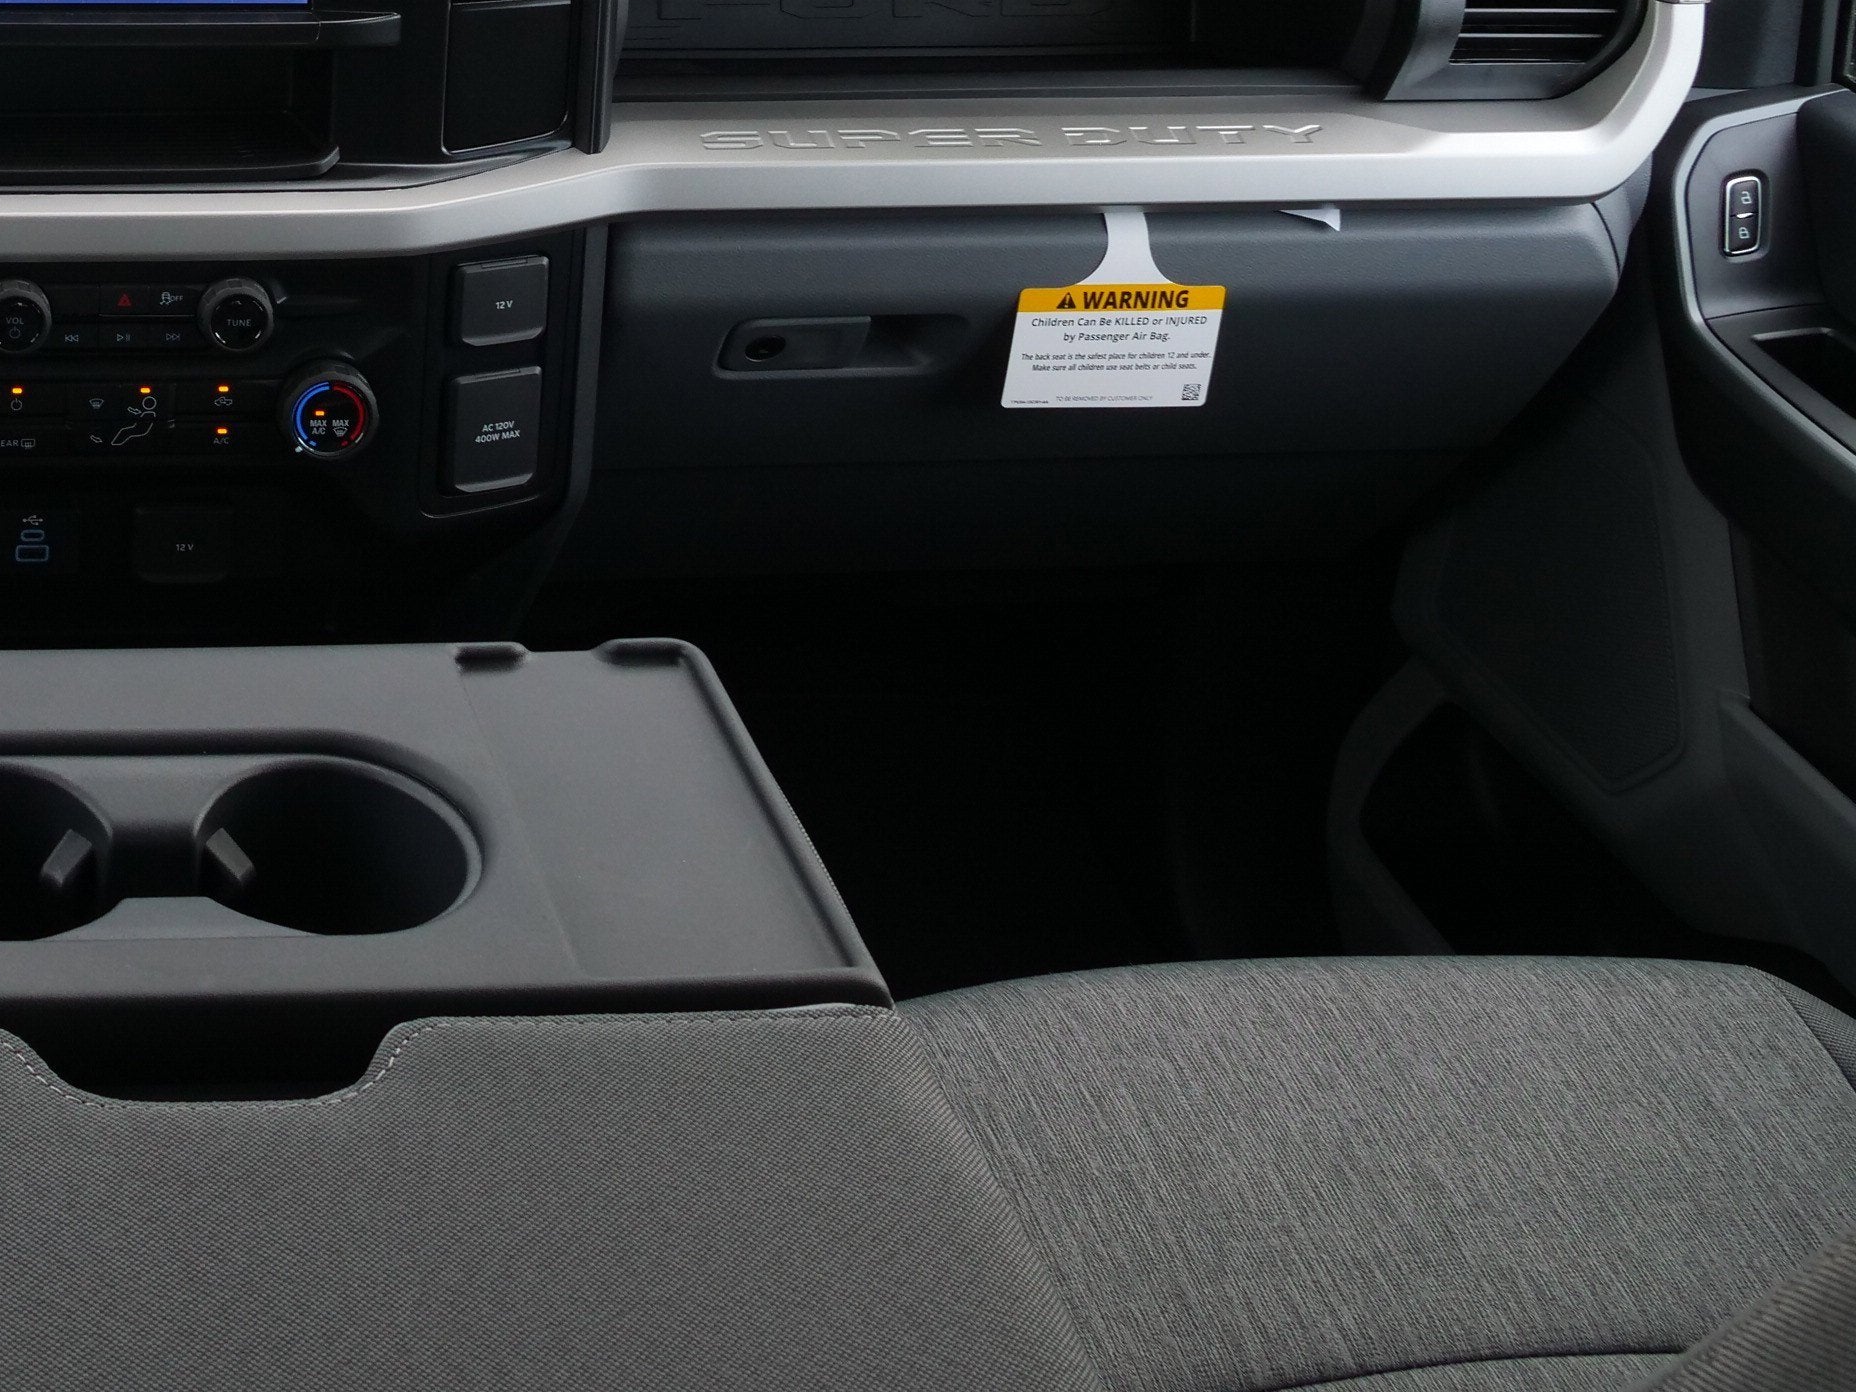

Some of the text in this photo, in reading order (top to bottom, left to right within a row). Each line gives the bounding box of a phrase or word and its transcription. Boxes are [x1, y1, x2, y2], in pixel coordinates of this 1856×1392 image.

[699, 122, 1325, 151] SUPER DUTY
[1083, 289, 1190, 310] WARNING
[5, 316, 24, 325] VOL
[227, 318, 251, 327] TUNE
[1031, 316, 1208, 327] Children Can Be KILLED or INJURED
[1063, 331, 1171, 343] by Passenger Air Bag.
[1021, 353, 1033, 361] The
[1108, 353, 1125, 361] place
[1128, 352, 1137, 360] for
[1167, 351, 1175, 359] 12
[1177, 351, 1188, 359] and
[1068, 363, 1076, 371] all
[1078, 363, 1104, 371] children
[309, 419, 327, 427] MAX
[332, 419, 349, 427] MAX
[482, 420, 515, 432] AC 120V
[311, 427, 326, 435] A/C
[475, 429, 521, 443] 400W MAX
[213, 437, 230, 445] A/C
